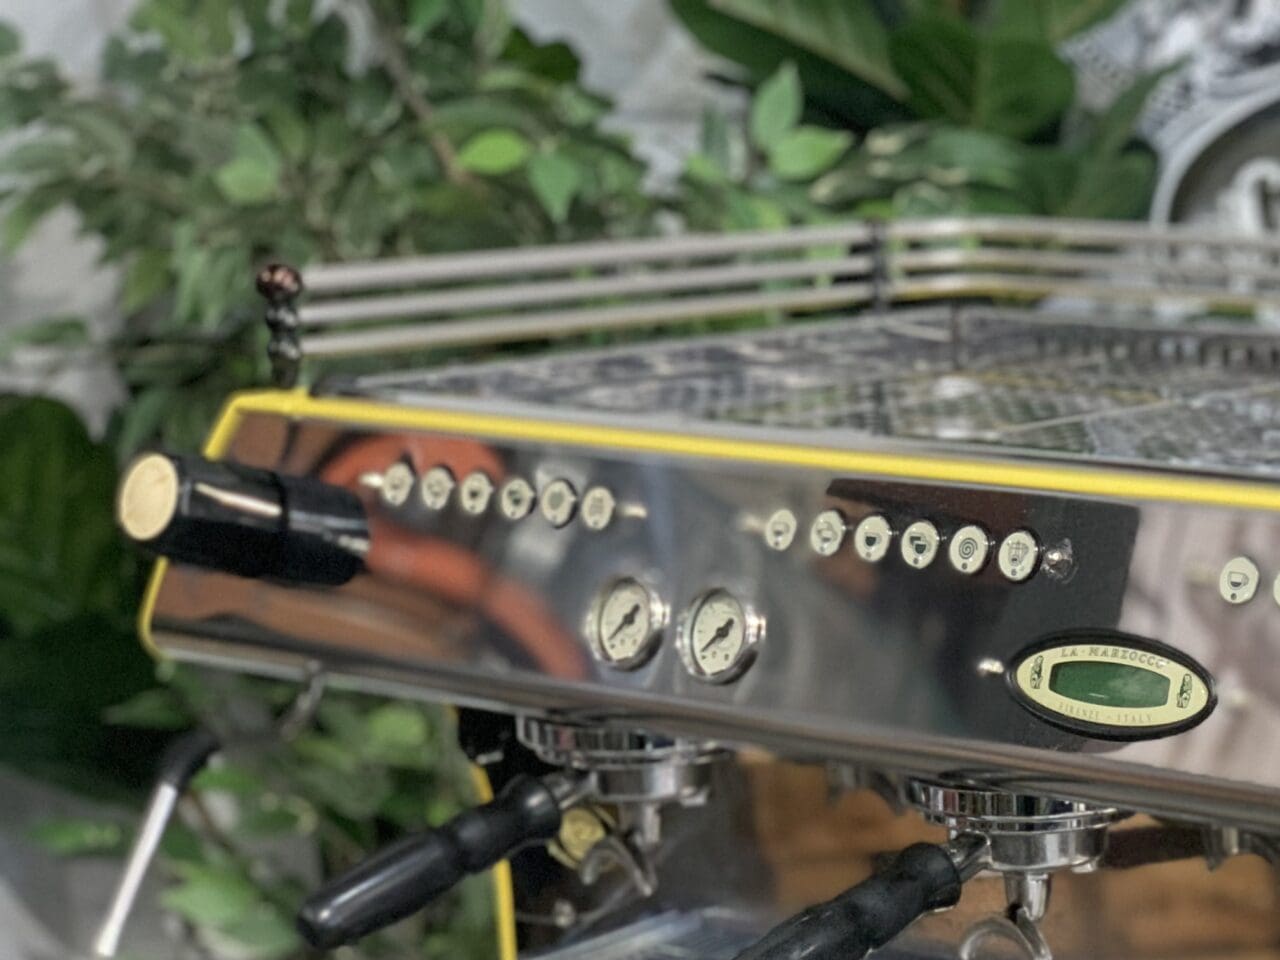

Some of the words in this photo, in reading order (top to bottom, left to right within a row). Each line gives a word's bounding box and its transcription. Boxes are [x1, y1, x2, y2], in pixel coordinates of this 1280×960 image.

[1060, 647, 1079, 657] LA
[1088, 646, 1165, 669] MARZOCCO
[1117, 712, 1152, 724] ITALY
